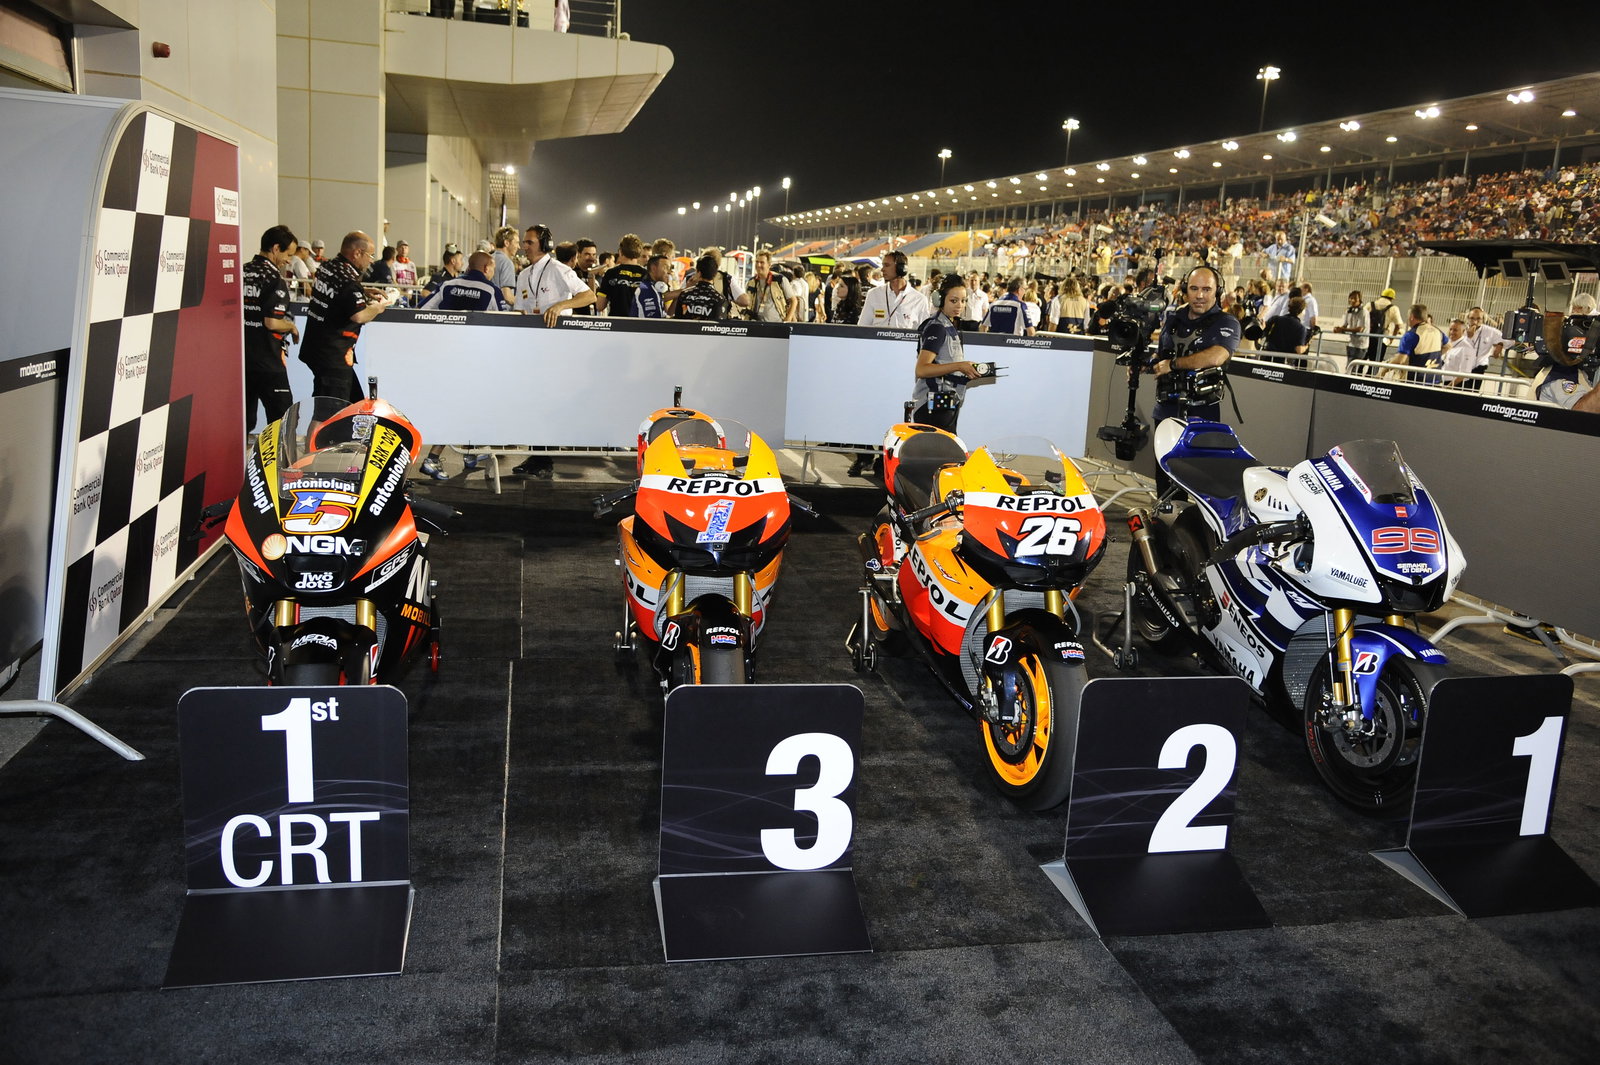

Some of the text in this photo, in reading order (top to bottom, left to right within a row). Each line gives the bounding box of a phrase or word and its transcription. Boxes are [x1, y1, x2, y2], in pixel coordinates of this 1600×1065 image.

[149, 150, 169, 165] Commercial
[150, 163, 168, 178] Bank Qatar
[103, 249, 129, 261] Commercial
[166, 250, 184, 261] Commercial
[104, 264, 128, 277] Bank Qatar
[166, 262, 184, 274] Bank Qatar
[415, 312, 467, 323] motogp.com
[562, 319, 612, 329] motogp.com
[701, 325, 748, 334] motogp.com
[1006, 338, 1052, 347] motogp.com
[124, 351, 148, 366] Commercial
[19, 360, 57, 378] motogp.com
[125, 365, 146, 380] Bank Qatar
[1251, 366, 1285, 379] motogp.com
[1350, 382, 1392, 396] motogp.com
[1481, 403, 1539, 420] motogp.com
[142, 440, 164, 461] Commercial
[369, 445, 390, 470] DARK
[143, 456, 163, 473] Bank Qatar
[282, 478, 355, 493] antoniolupi
[369, 443, 411, 516] antoniolupi
[1314, 460, 1345, 492] YAMAHA
[73, 474, 102, 501] Commercial
[667, 477, 764, 496] REPSOL
[73, 492, 101, 515] Bank Qatar
[280, 489, 360, 535] 5
[996, 495, 1086, 513] REPSOL
[696, 499, 736, 544] 1
[160, 523, 179, 546] Commercial
[1013, 515, 1082, 558] 26
[1371, 526, 1440, 555] 99
[160, 537, 178, 557] Bank Qatar
[285, 535, 363, 556] NGM
[380, 548, 410, 576] GPS
[97, 568, 124, 598] Commercial
[295, 579, 333, 589] dots
[1330, 567, 1369, 588] YAMALUBE
[98, 583, 123, 612] Bank Qatar
[705, 626, 740, 636] REPSOL
[1228, 602, 1266, 659] ENEOS
[1212, 633, 1256, 685] YAMAHA
[1512, 716, 1563, 837] 1
[1147, 723, 1238, 853] 2
[760, 732, 853, 870] 3
[220, 811, 381, 888] CRT
